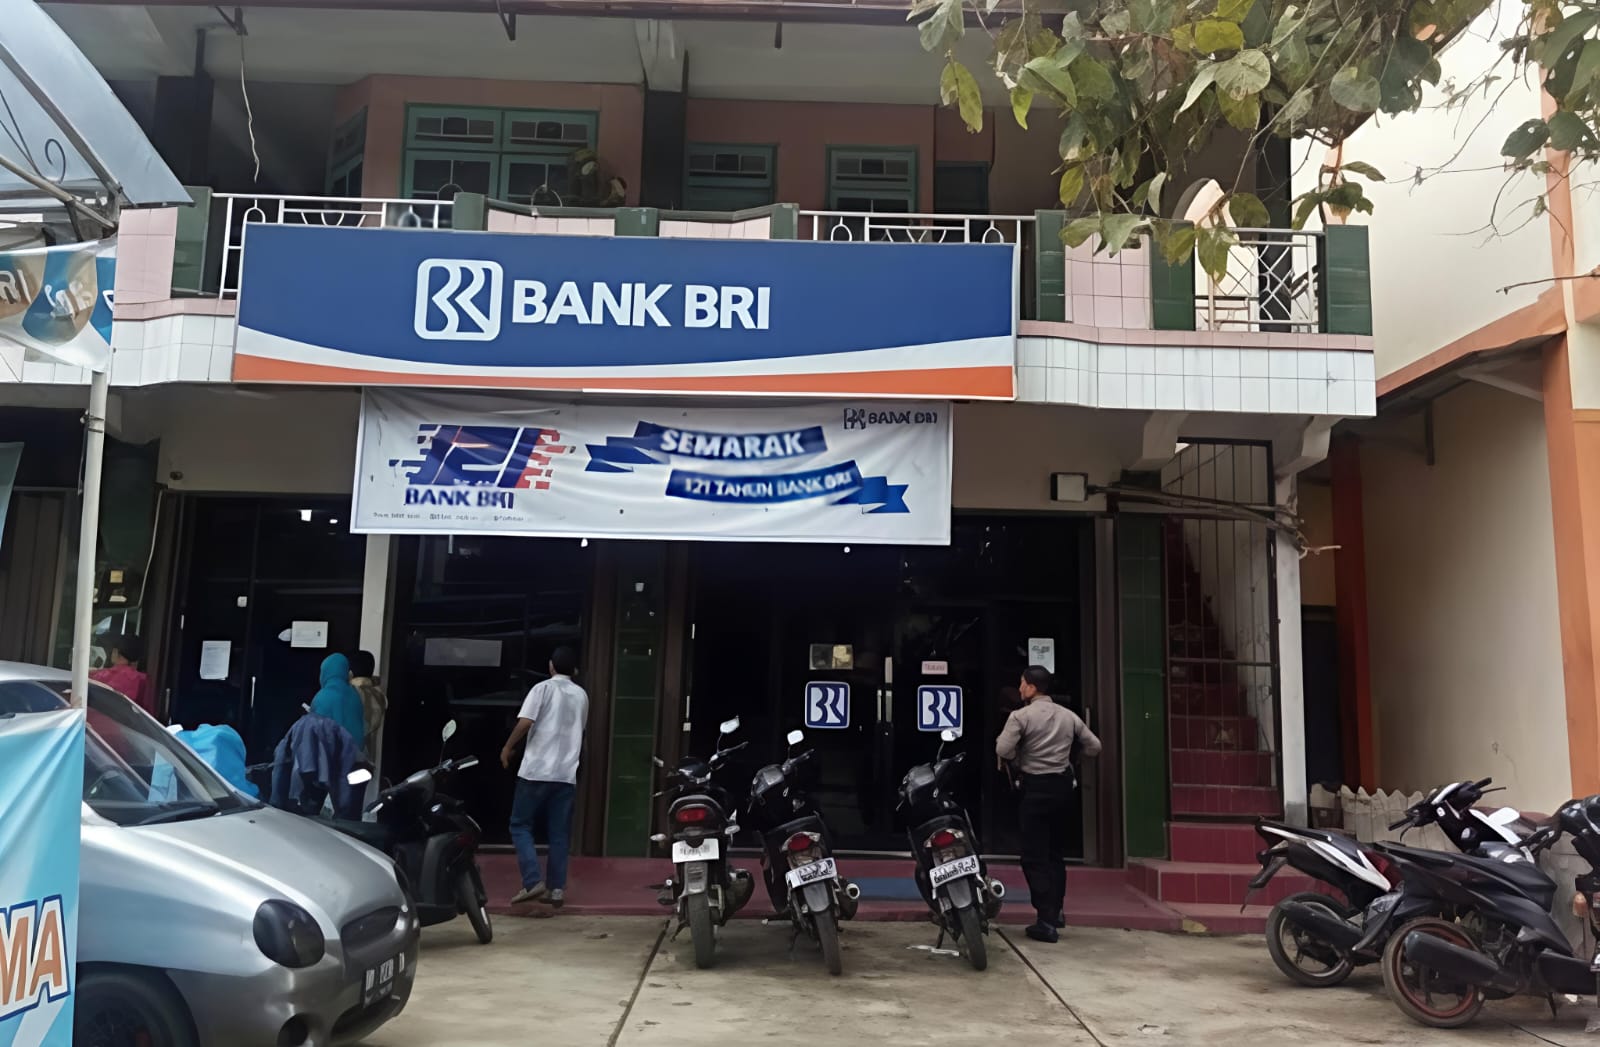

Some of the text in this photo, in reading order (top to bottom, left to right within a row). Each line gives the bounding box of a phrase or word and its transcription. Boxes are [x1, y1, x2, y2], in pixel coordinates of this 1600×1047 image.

[512, 280, 672, 328] BANK
[684, 285, 771, 330] BRI
[660, 429, 806, 458] SEMARAK
[404, 487, 515, 510] BANK BRI
[684, 478, 711, 496] 121
[713, 479, 774, 497] TAHUN
[776, 476, 823, 497] BANK
